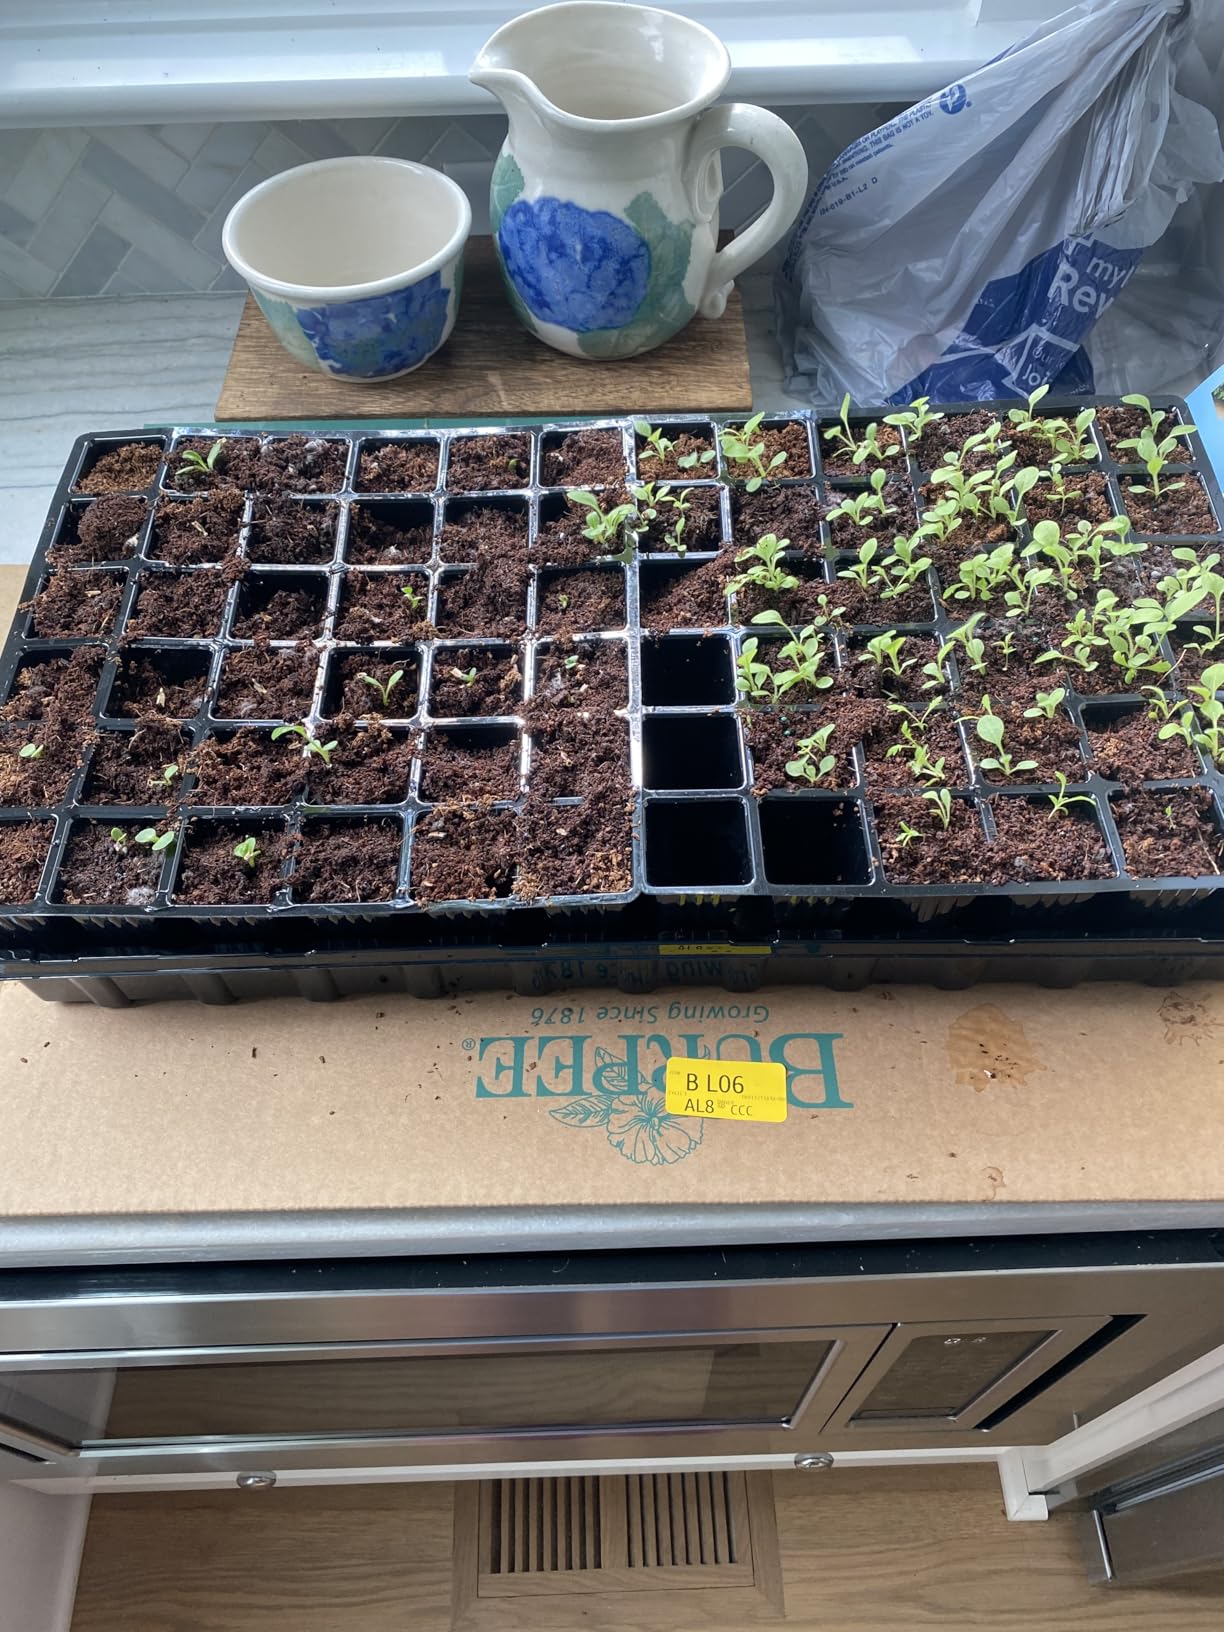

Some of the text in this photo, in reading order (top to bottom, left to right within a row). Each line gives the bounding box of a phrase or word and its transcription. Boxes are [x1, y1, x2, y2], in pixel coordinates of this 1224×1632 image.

[902, 120, 914, 131] NOT
[530, 1001, 770, 1026] Growing Since 1876
[686, 1073, 699, 1091] B
[684, 1098, 715, 1114] AL8
[730, 1104, 754, 1117] CCC
